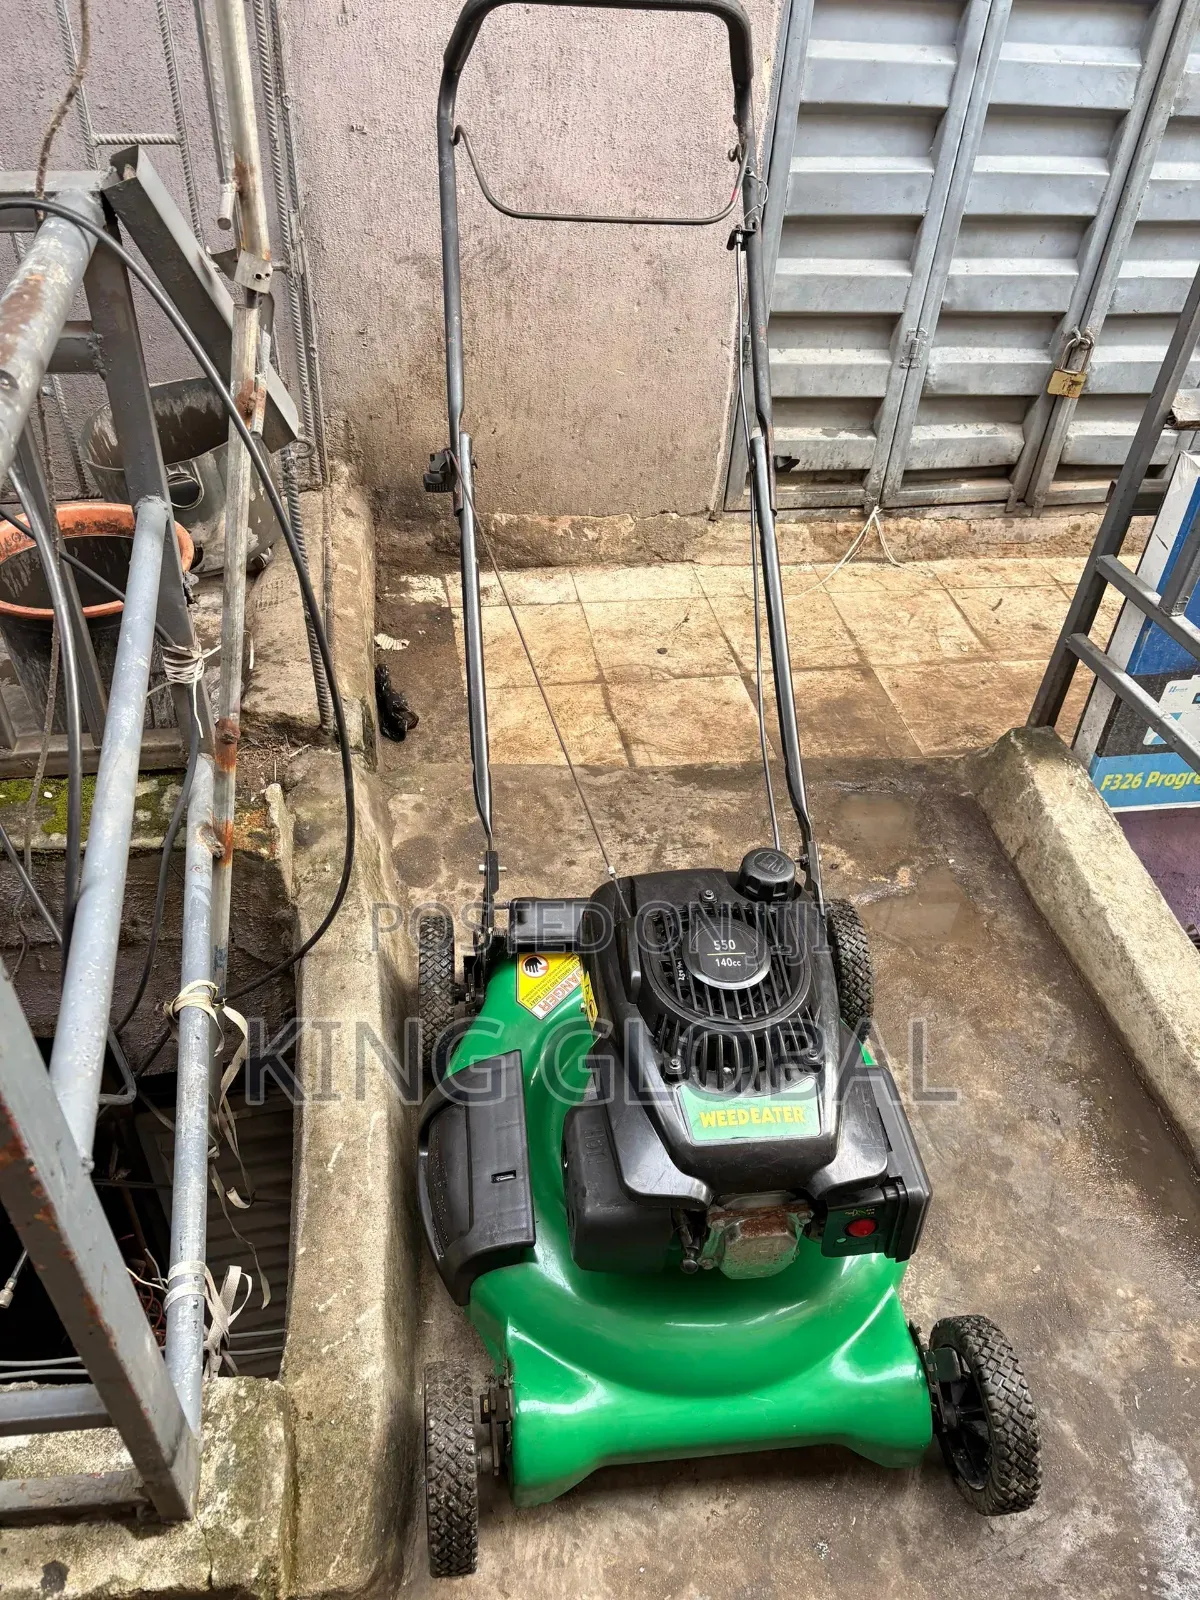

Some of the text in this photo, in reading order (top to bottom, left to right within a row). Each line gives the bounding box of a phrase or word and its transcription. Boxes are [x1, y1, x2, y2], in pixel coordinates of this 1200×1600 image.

[1100, 772, 1144, 791] F326
[713, 939, 736, 951] 550
[715, 957, 742, 967] 140cc
